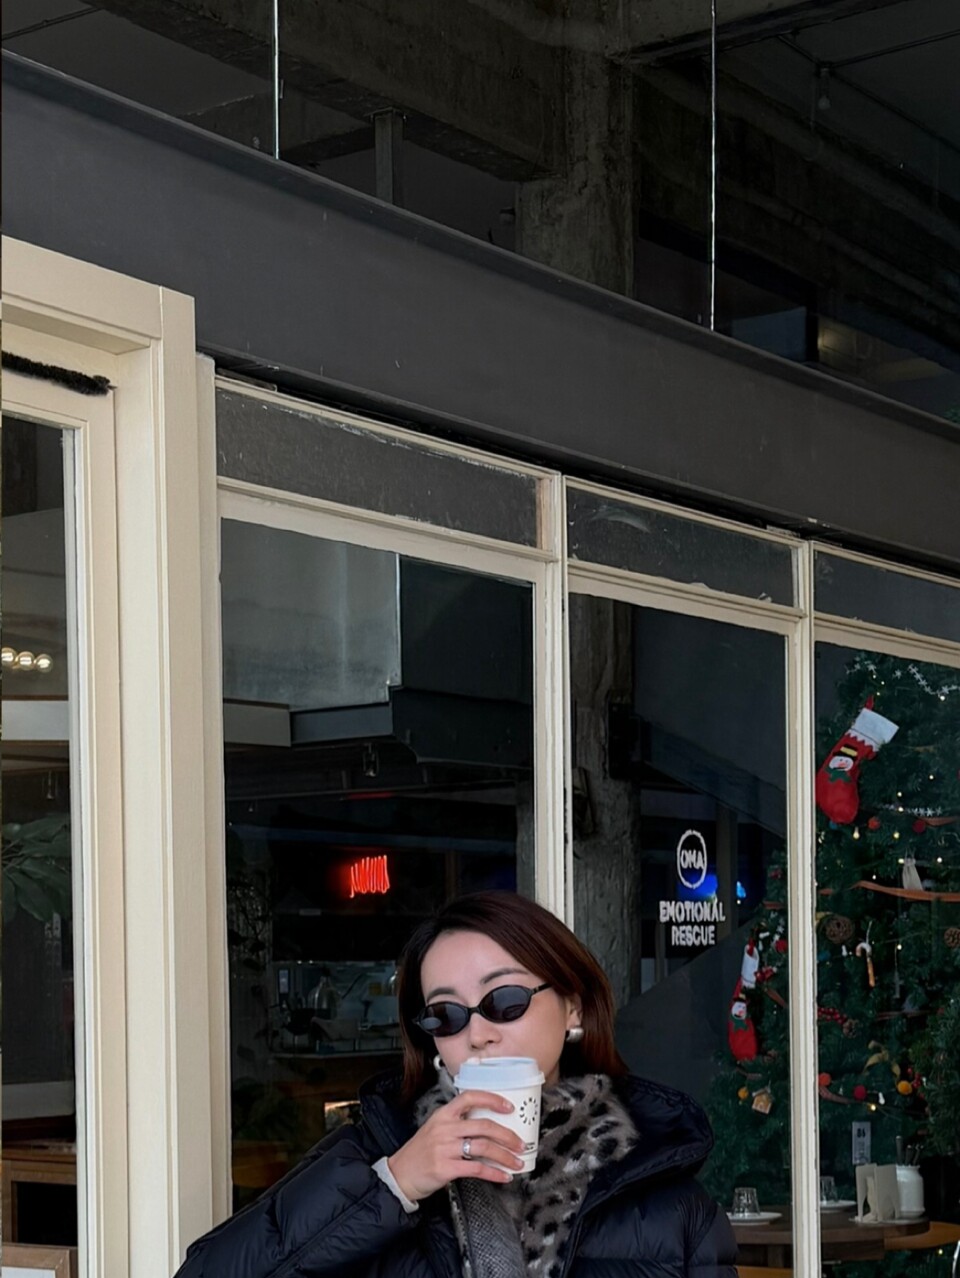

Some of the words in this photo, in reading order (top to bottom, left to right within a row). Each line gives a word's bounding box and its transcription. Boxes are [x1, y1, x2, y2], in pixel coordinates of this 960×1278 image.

[681, 849, 704, 869] OMA
[659, 901, 726, 923] EMOTIONAL
[672, 925, 715, 945] RESCUE
